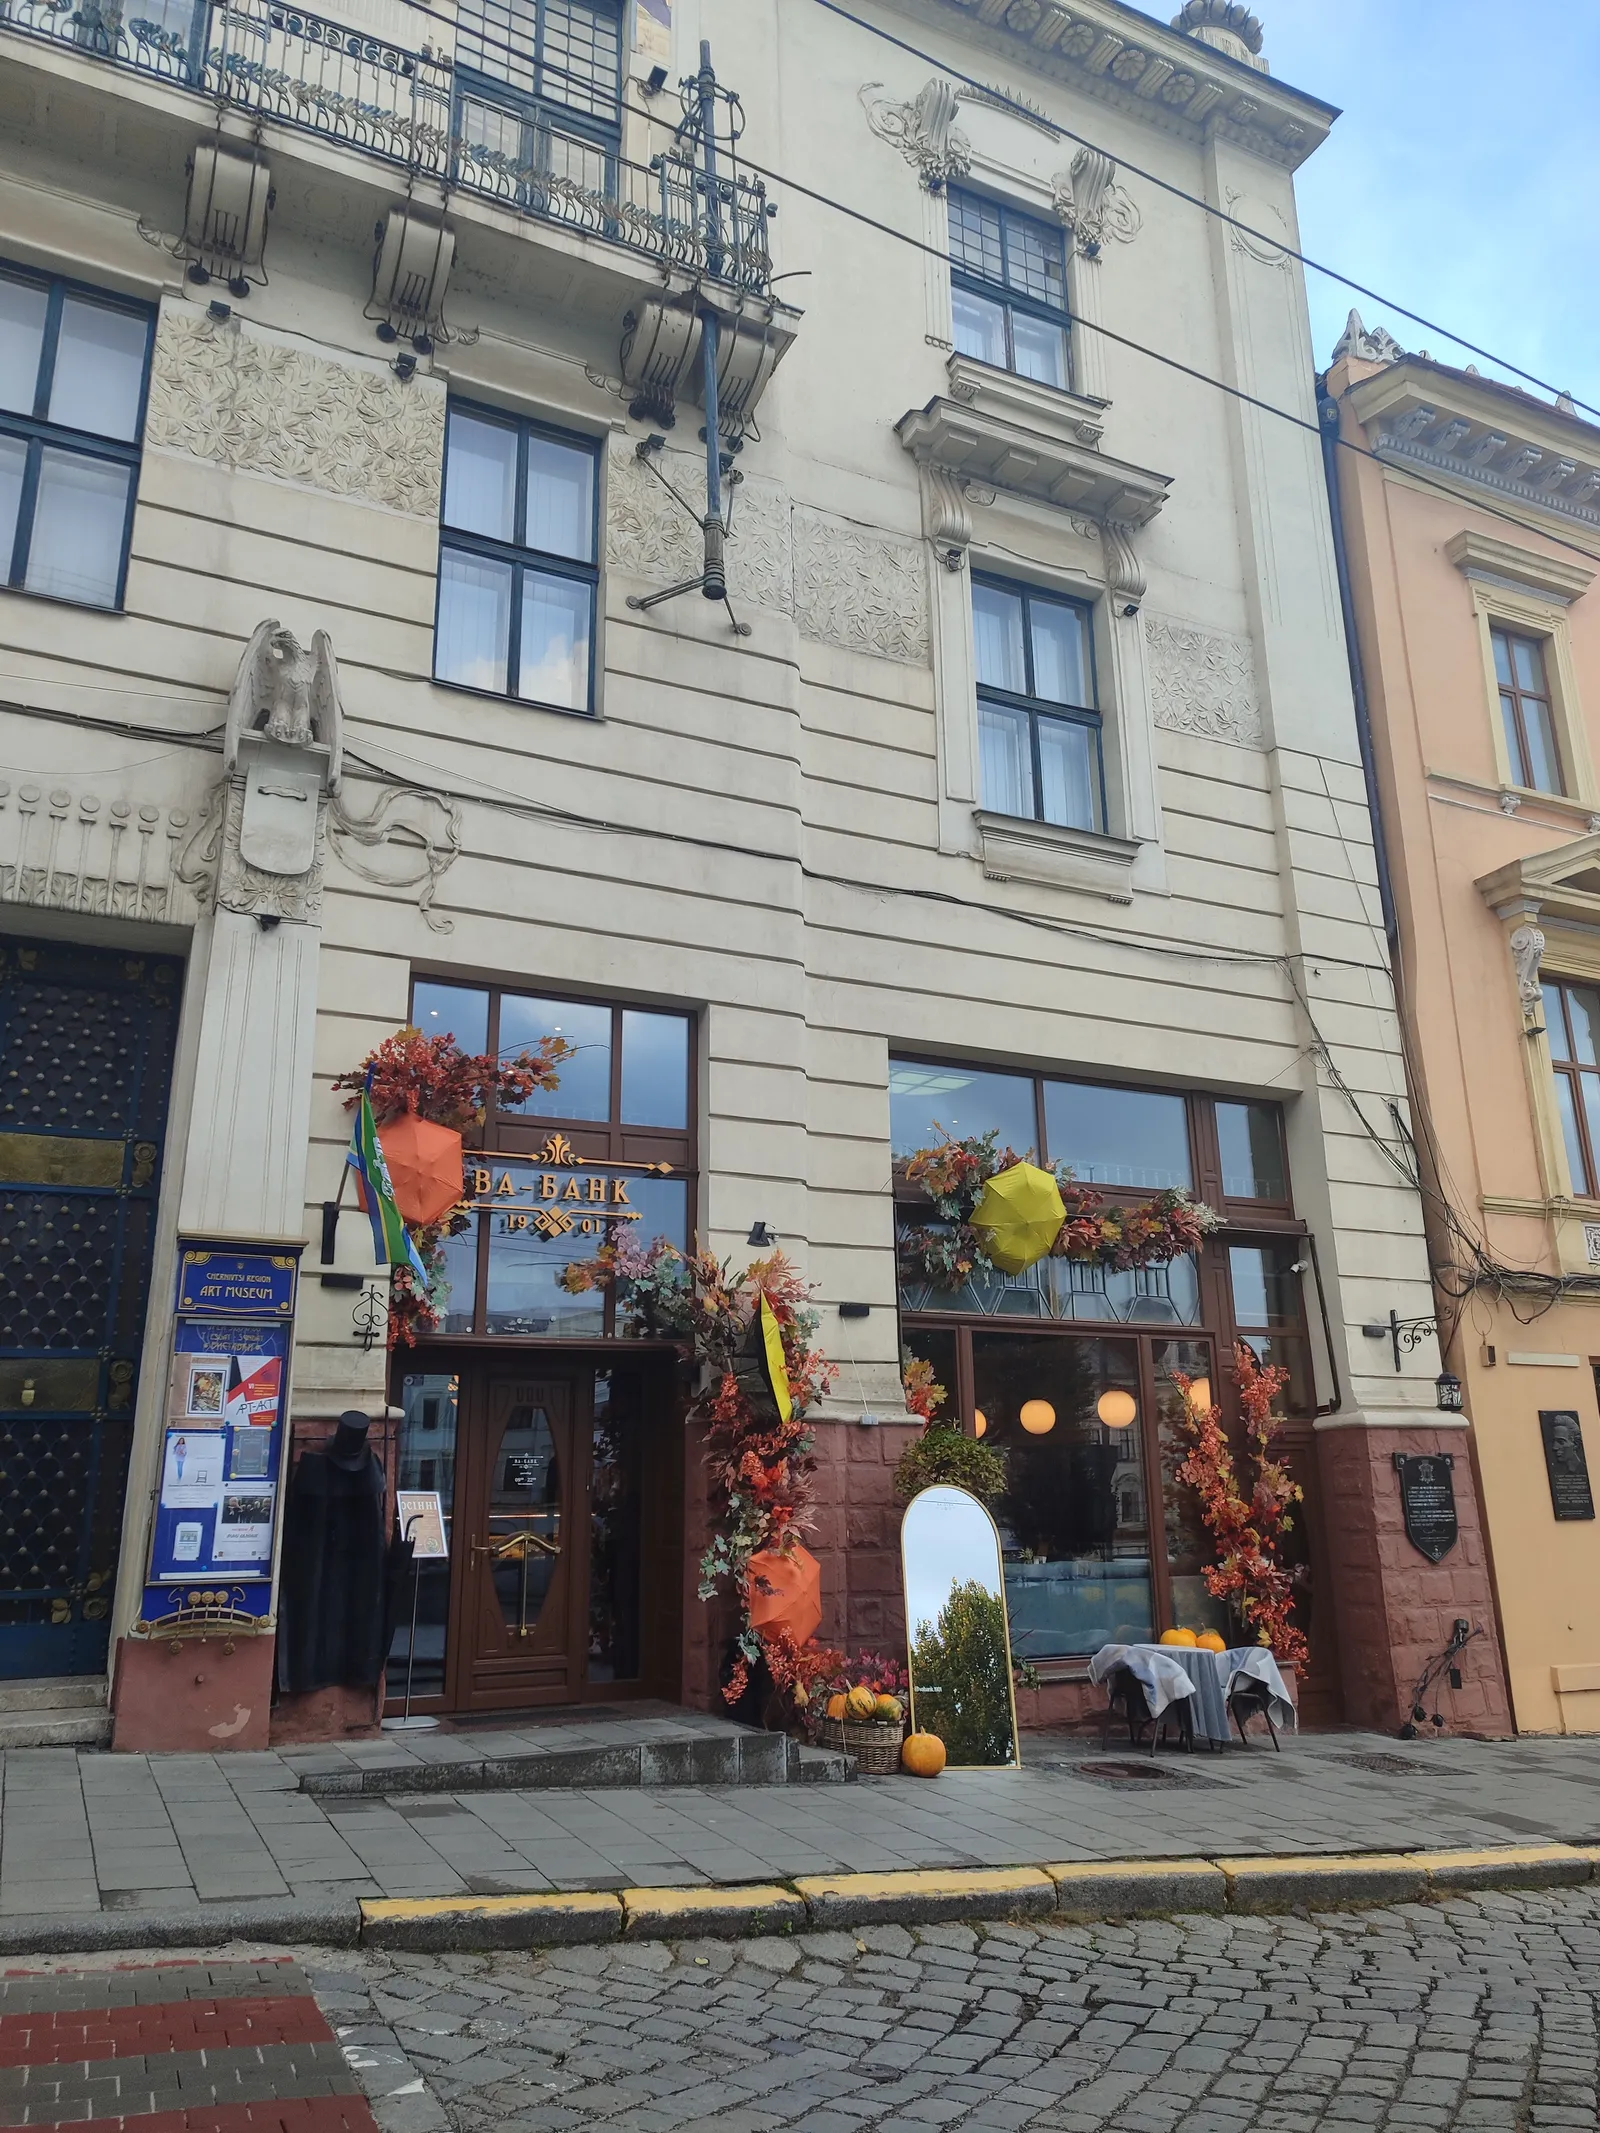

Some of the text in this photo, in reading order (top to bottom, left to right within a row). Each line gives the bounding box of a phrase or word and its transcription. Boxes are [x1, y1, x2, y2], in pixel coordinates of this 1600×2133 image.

[474, 1169, 631, 1204] ВА-БАНК
[508, 1214, 601, 1233] 19 01
[206, 1272, 271, 1283] CHERNIVTSI REGION
[200, 1285, 273, 1300] ART MUSEUM
[236, 1399, 274, 1416] АРТ-АКТ
